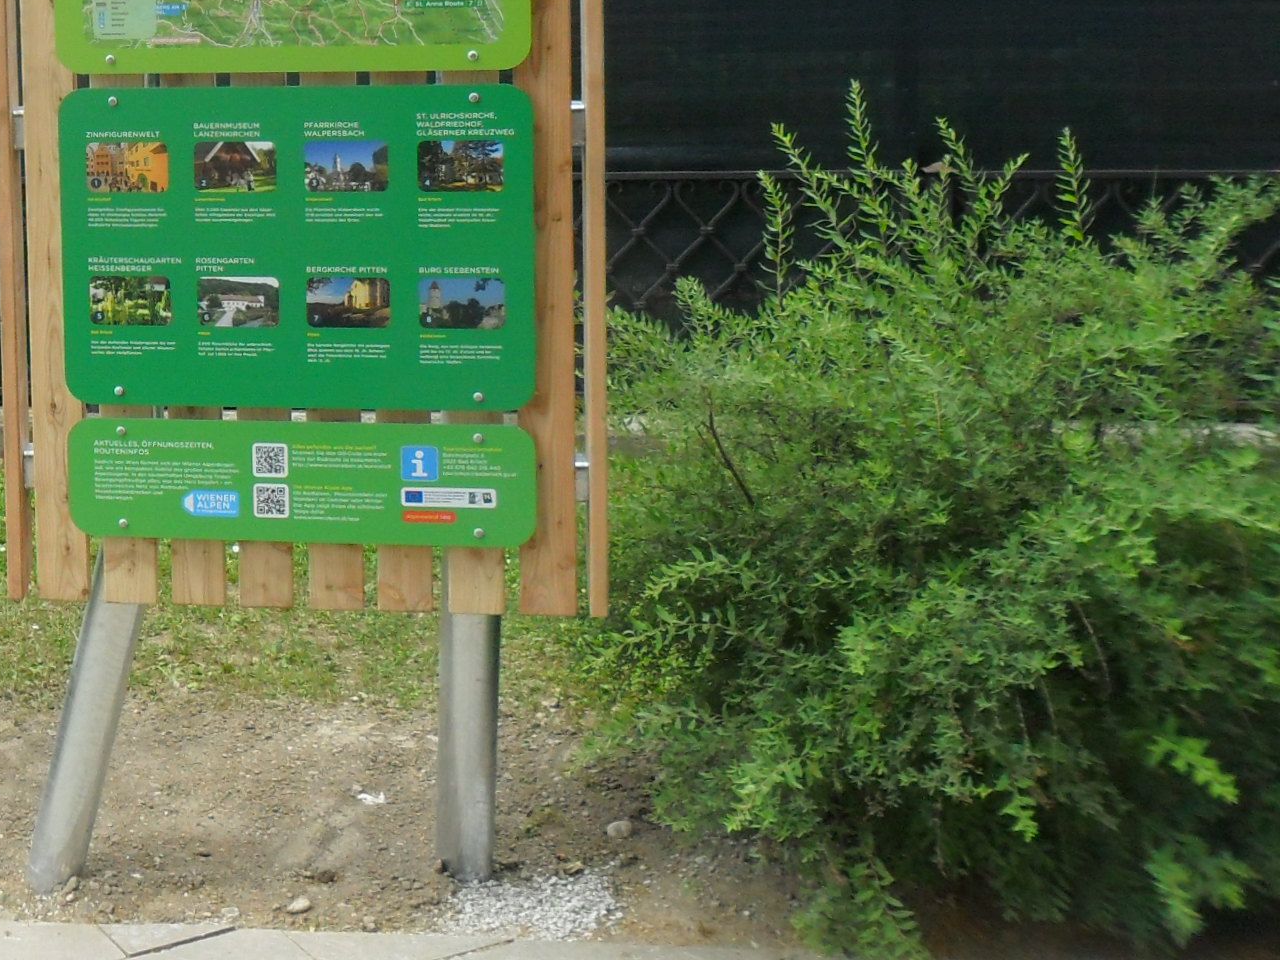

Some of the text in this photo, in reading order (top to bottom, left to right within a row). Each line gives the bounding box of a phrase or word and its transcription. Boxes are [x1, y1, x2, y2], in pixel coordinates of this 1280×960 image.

[193, 122, 260, 131] BAUERNMUSEUM
[304, 121, 360, 130] PFARRKIRCHE
[86, 130, 160, 139] ZINNFIGURENWELT
[193, 130, 261, 138] LANZENKIRCHEN
[304, 129, 365, 138] WALPERSBACH
[88, 255, 182, 265] KRÄUTERSCHAUGARTEN
[195, 256, 256, 265] ROSENGARTEN
[88, 264, 152, 273] HEISSENBERGER
[195, 265, 224, 273] PITTEN
[306, 266, 388, 275] BERGKIRCHE PITTEN
[418, 266, 500, 275] BURG SEEBENSTEIN
[93, 448, 150, 456] ROUTENINFOS
[196, 494, 236, 502] WIENER
[197, 501, 230, 510] ALPEN
